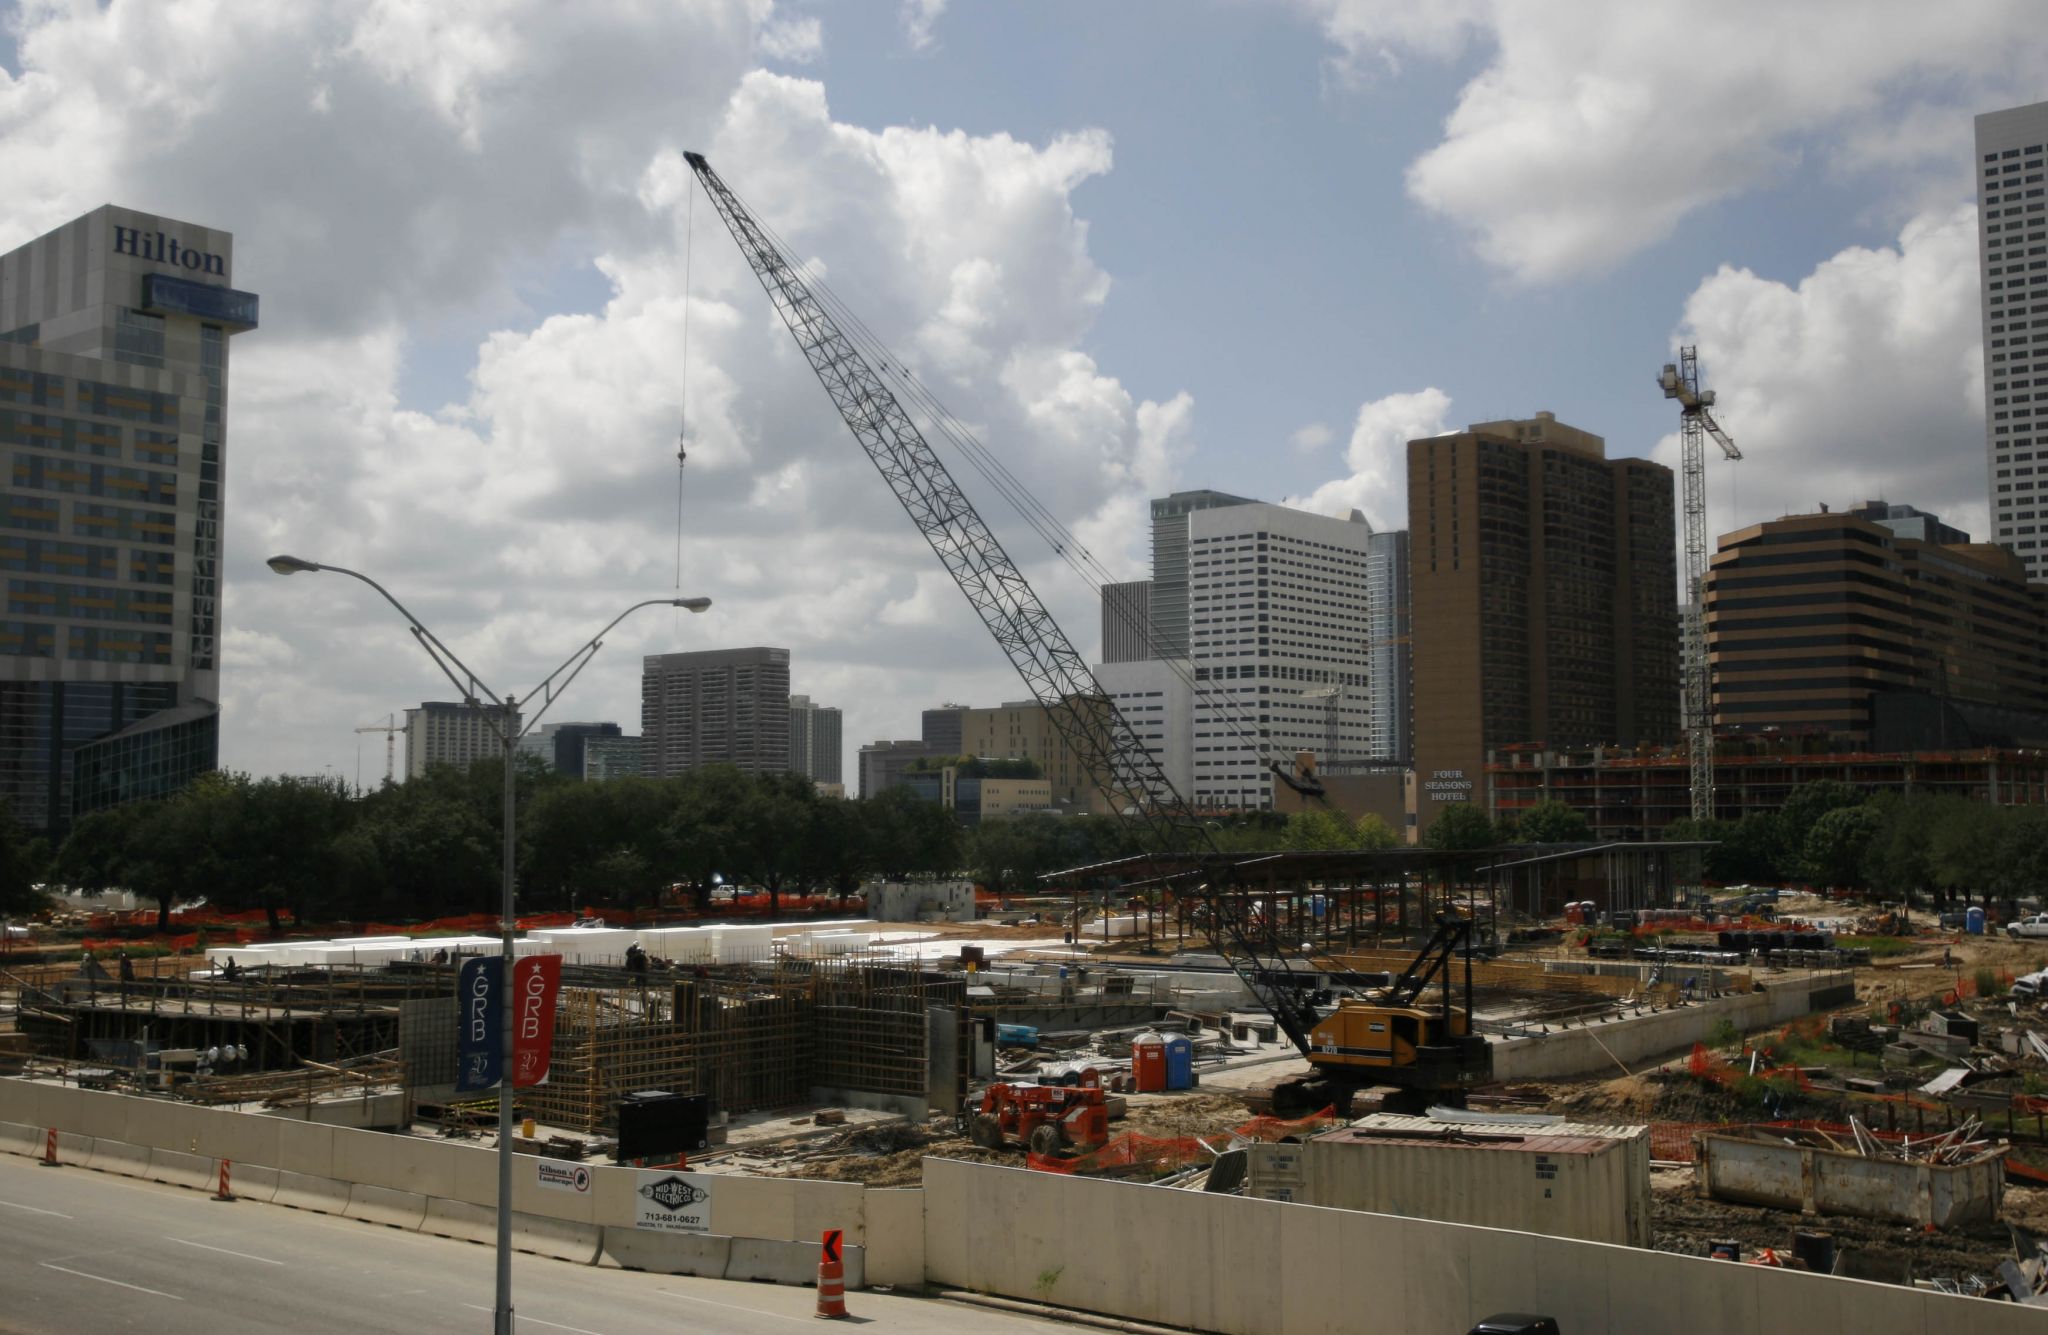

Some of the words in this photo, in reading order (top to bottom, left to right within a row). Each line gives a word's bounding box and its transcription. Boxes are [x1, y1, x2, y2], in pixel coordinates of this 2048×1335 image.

[114, 225, 225, 276] Hilton
[1433, 770, 1463, 779] FOUR
[1424, 781, 1472, 790] SEASONS
[1431, 792, 1466, 801] HOTEL
[471, 976, 489, 1042] GRB
[521, 975, 545, 1039] GRB
[539, 1165, 573, 1176] Gibson's
[539, 1174, 573, 1186] Landscape
[655, 1182, 692, 1194] MID-WEST
[655, 1193, 683, 1205] ELECTRIC
[645, 1213, 701, 1224] 713-681-0627
